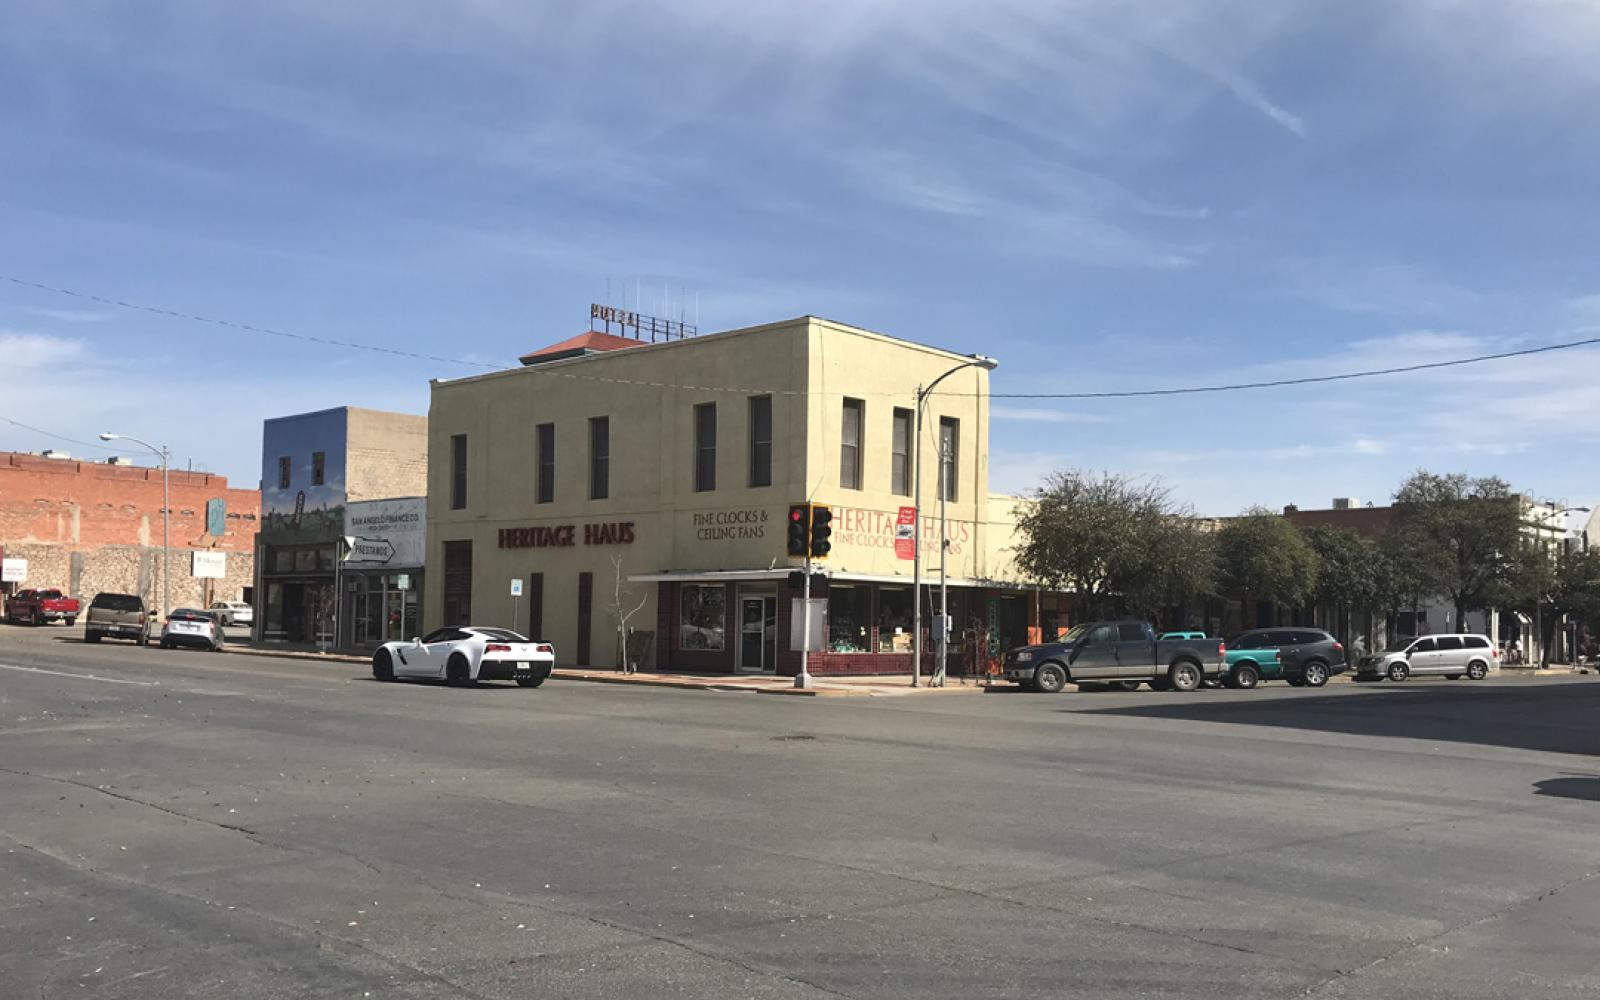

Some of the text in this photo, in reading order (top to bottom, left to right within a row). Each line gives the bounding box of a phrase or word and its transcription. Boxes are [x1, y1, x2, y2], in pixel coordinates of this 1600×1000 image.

[693, 509, 769, 526] FINE CLOCKS &
[497, 522, 635, 549] HERITAGE HAUS
[697, 525, 765, 541] CEILING FANS
[834, 530, 855, 545] FINE
